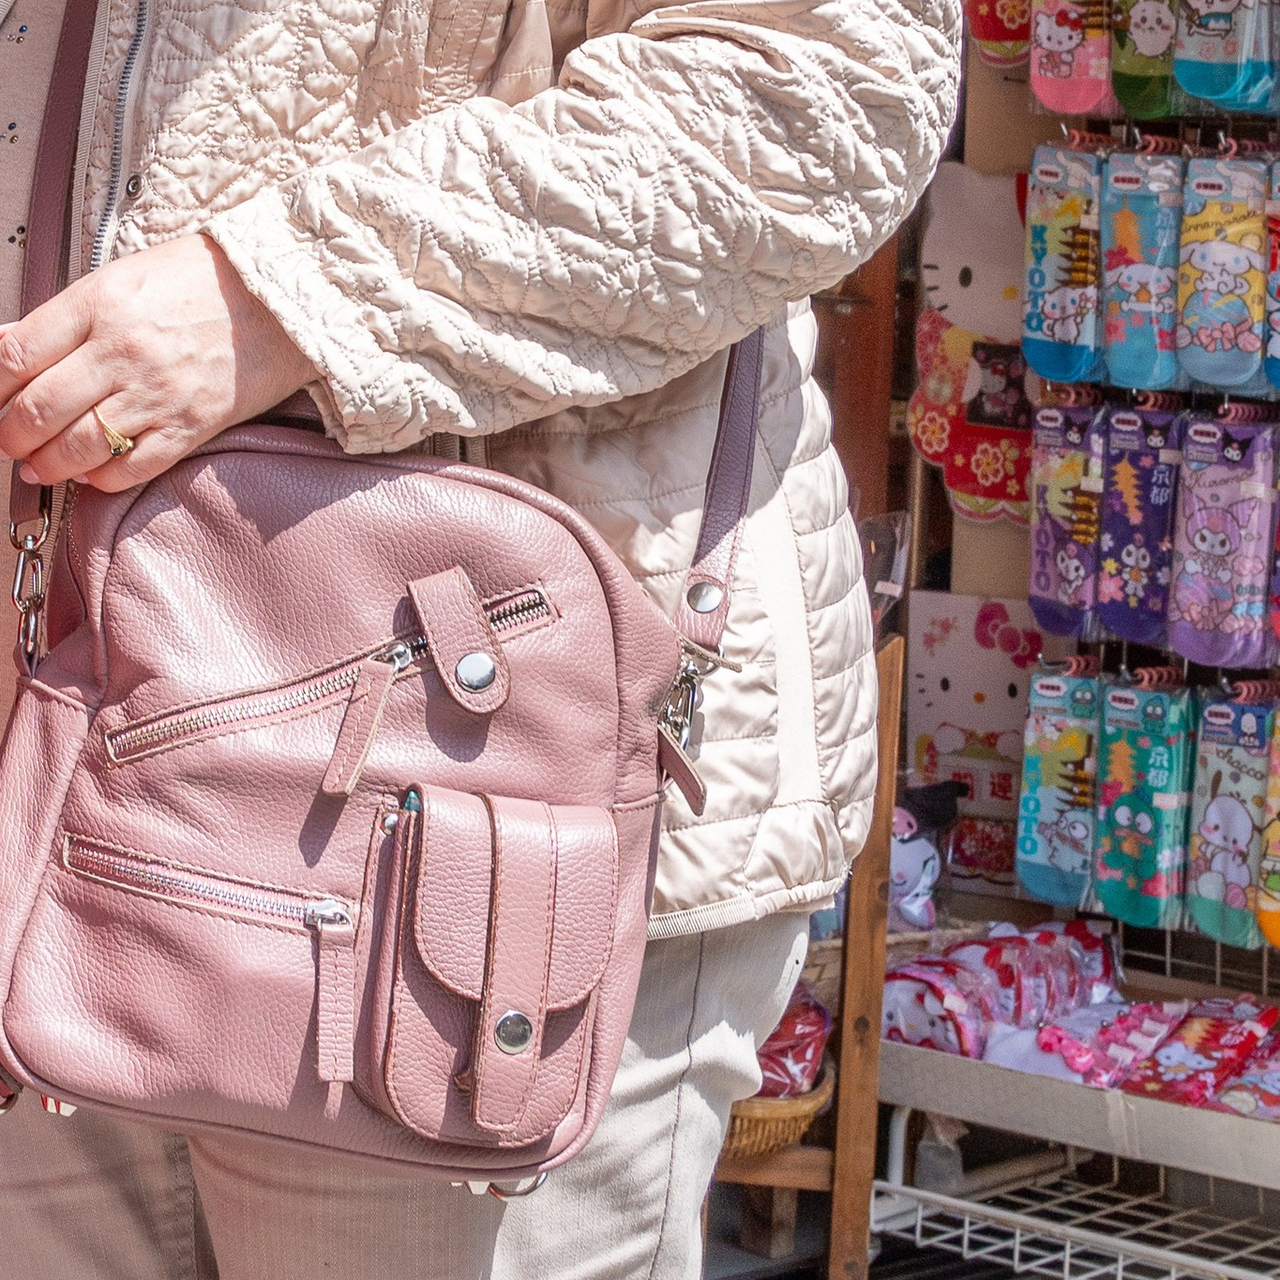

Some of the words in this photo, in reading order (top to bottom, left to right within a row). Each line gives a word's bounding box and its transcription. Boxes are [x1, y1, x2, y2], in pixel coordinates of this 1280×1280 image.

[1026, 225, 1047, 333] KYOTO
[1150, 464, 1170, 506] 京都
[1148, 746, 1169, 787] 京都
[1019, 755, 1042, 855] KYOTO
